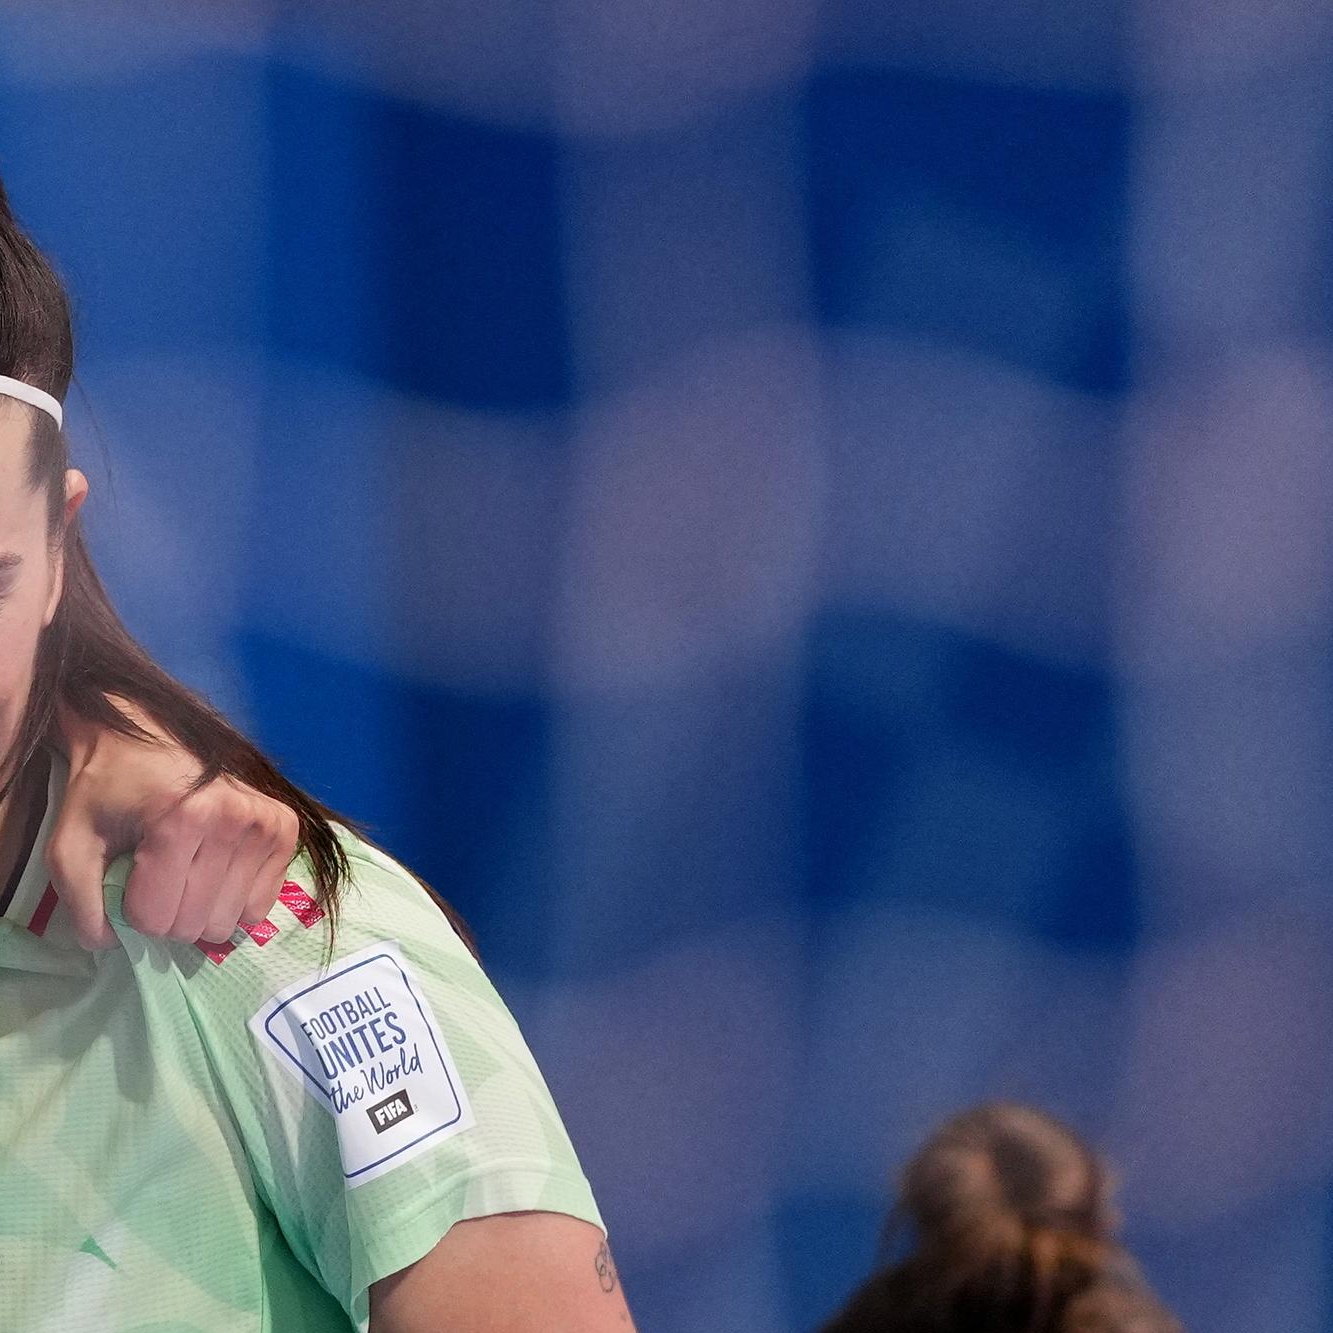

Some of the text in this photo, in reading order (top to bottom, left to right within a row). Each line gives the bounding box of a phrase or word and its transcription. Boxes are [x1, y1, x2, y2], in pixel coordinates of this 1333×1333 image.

[300, 986, 392, 1047] FOOTBALL
[315, 1011, 407, 1080] UNITES
[329, 1043, 424, 1115] the World
[373, 1098, 408, 1127] FIFA
